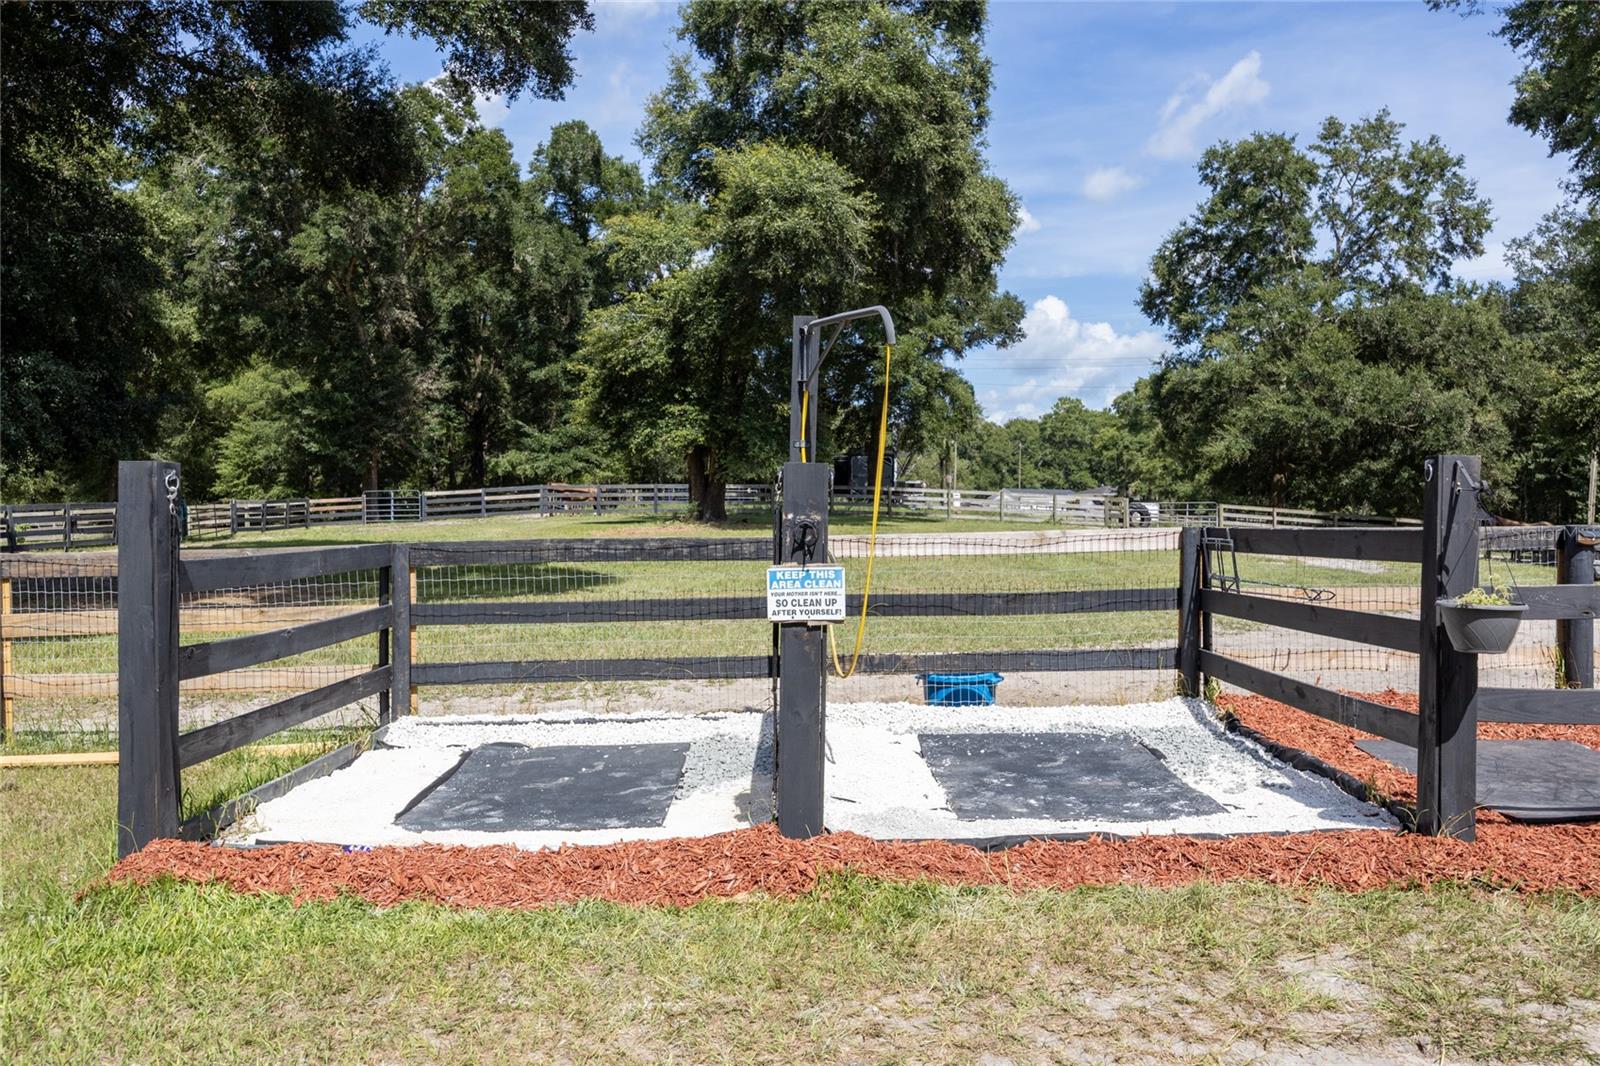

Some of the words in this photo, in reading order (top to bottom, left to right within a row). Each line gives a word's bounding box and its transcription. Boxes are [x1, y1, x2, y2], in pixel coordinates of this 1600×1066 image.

[776, 571, 806, 580] KEEP
[809, 570, 835, 579] THIS
[771, 580, 801, 589] AREA
[804, 579, 841, 588] CLEAN
[775, 599, 788, 607] SO
[791, 598, 822, 607] CLEAN
[825, 598, 837, 607] UP
[799, 608, 842, 616] YOURSELF!
